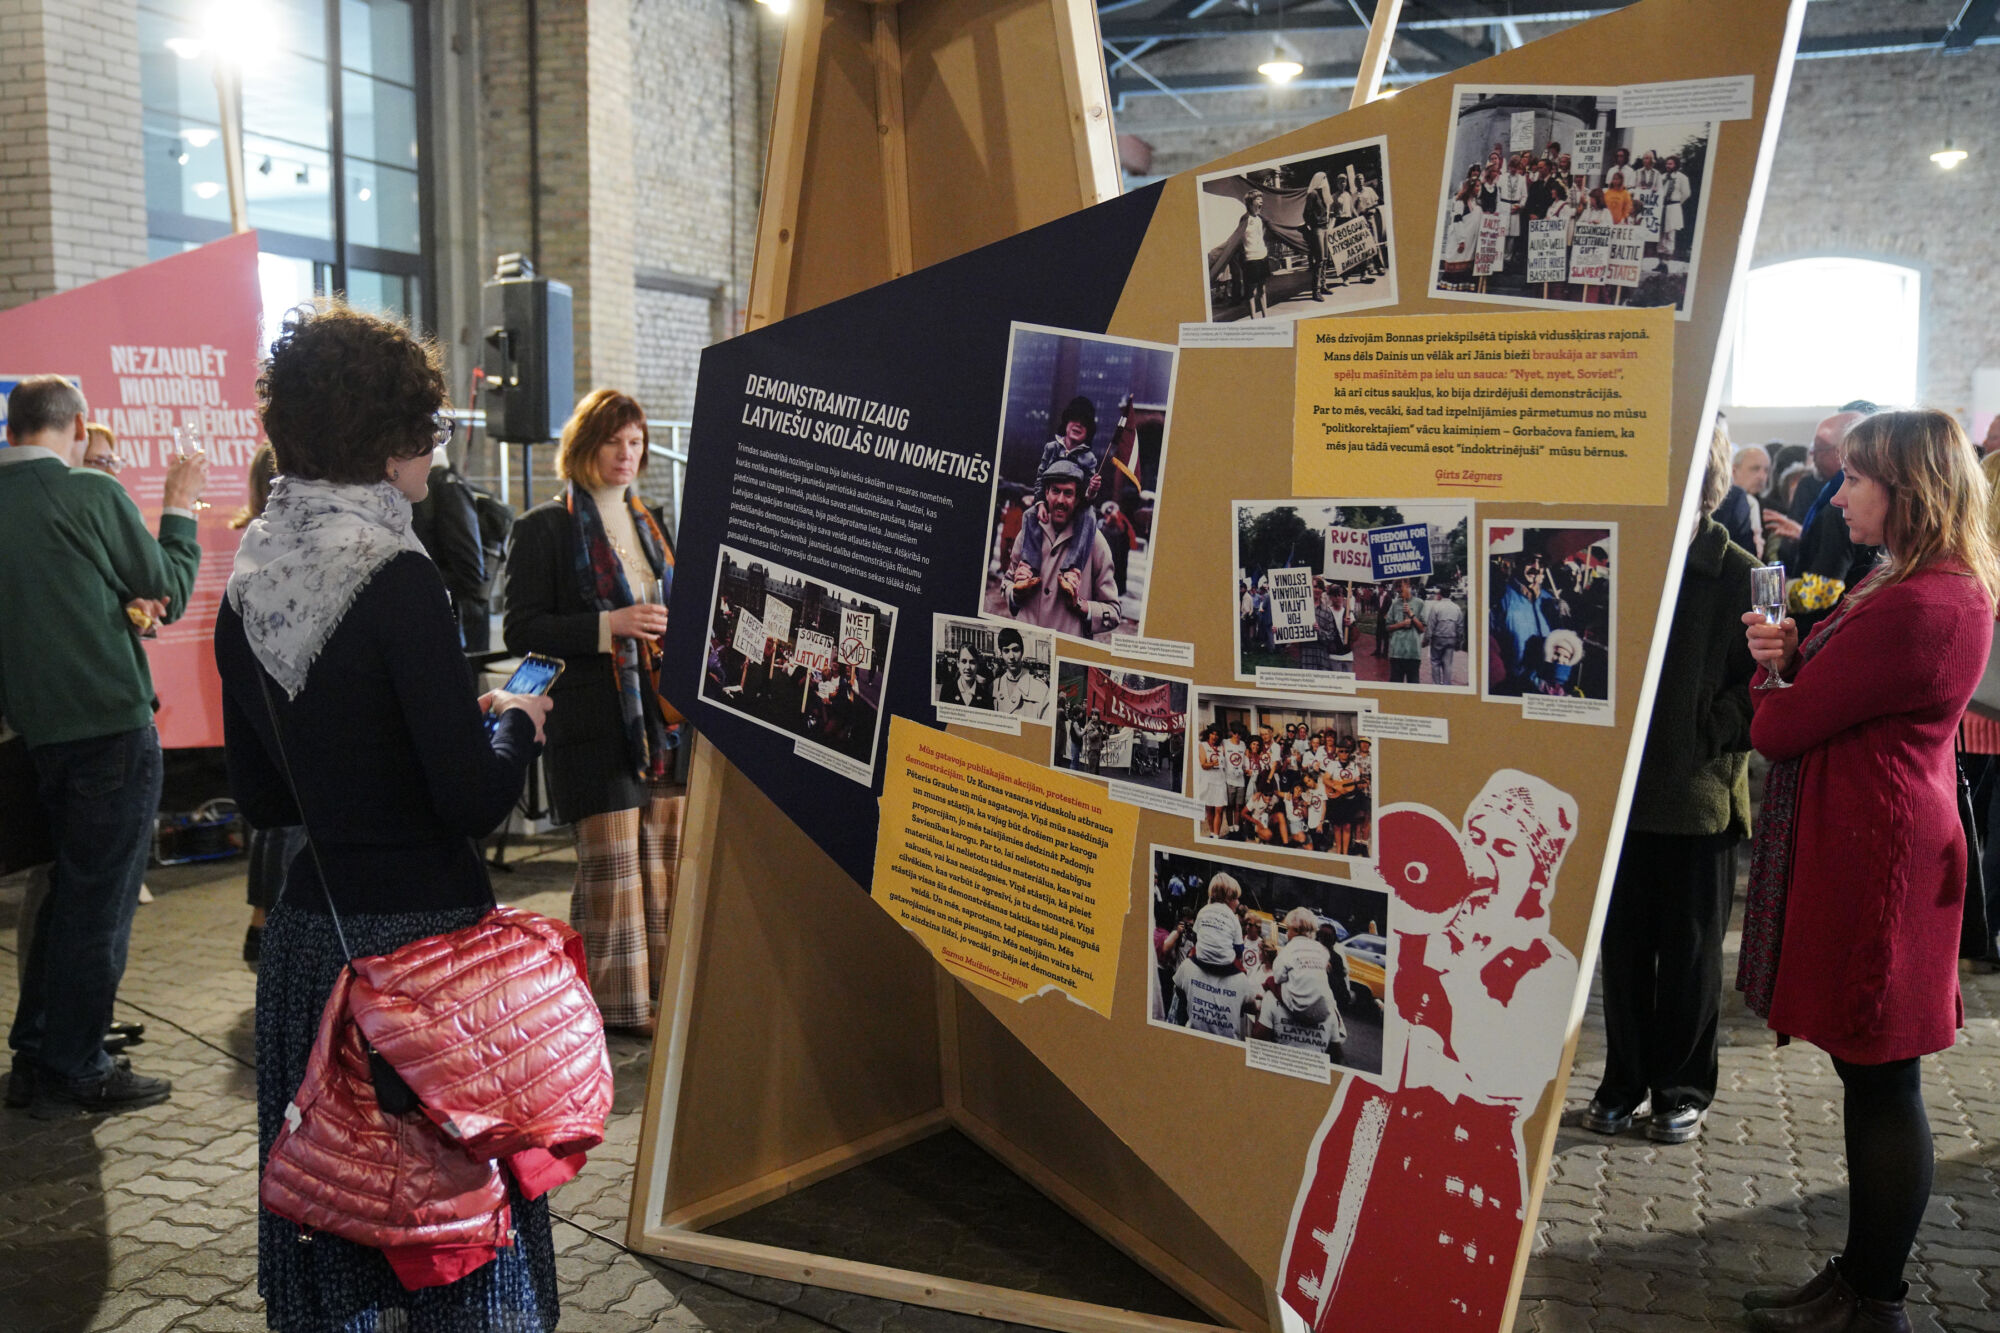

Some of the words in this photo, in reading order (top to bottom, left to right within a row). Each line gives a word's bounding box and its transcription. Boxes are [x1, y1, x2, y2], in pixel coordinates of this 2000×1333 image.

[1611, 228, 1634, 241] FREE
[1610, 244, 1641, 261] BALTIC
[1529, 269, 1565, 282] BASEMENT
[1606, 264, 1639, 281] STATES
[1315, 333, 1336, 343] Mēs
[1337, 332, 1383, 345] dzīvojām
[1385, 332, 1424, 342] Bonnas
[1425, 330, 1496, 344] priekšpilsētā
[1497, 329, 1536, 343] tipiskā
[1538, 328, 1606, 342] vidusšķiras
[1607, 328, 1649, 342] rajonā.
[110, 345, 228, 377] NEZAUDĒT
[1323, 351, 1351, 361] Mans
[1352, 350, 1373, 361] dēls
[1375, 350, 1408, 360] Dainis
[1426, 349, 1454, 360] vēlāk
[1455, 350, 1471, 360] arī
[1472, 349, 1501, 360] Jānis
[1503, 349, 1530, 359] bieži
[1532, 348, 1582, 362] braukāja
[1584, 351, 1597, 359] ar
[1599, 348, 1638, 359] savām
[1333, 368, 1360, 381] spēļu
[1362, 369, 1418, 379] mašīnītēm
[1419, 371, 1432, 382] pa
[1434, 368, 1454, 379] ielu
[1456, 371, 1471, 379] un
[1472, 371, 1507, 379] sauca:
[1546, 369, 1575, 381] nyet,
[744, 373, 861, 419] DEMONSTRANTI
[861, 400, 909, 430] IZAUG
[1334, 386, 1346, 397] kā
[1348, 387, 1362, 397] arī
[1364, 387, 1389, 397] citus
[1391, 386, 1434, 400] saukļus,
[1436, 386, 1449, 397] ko
[1450, 386, 1471, 400] bija
[1472, 386, 1528, 400] dzirdējuši
[1529, 387, 1622, 401] demonstrācijās.
[1312, 404, 1330, 414] Par
[1331, 405, 1342, 414] to
[1343, 405, 1366, 416] mēs,
[1368, 405, 1403, 416] vecāki,
[1405, 405, 1424, 415] šad
[1425, 405, 1443, 416] tad
[1445, 405, 1517, 419] izpelnījāmies
[1518, 407, 1593, 419] pārmetumus
[1595, 410, 1611, 418] no
[1612, 408, 1647, 418] mūsu
[94, 404, 175, 437] KAMĒR
[1415, 424, 1440, 434] vācu
[1442, 424, 1500, 437] kaimiņiem
[1512, 425, 1572, 436] Gorbačova
[1574, 426, 1618, 438] faniem,
[1620, 426, 1634, 438] ka
[741, 403, 812, 438] LATVIEŠU
[812, 420, 872, 453] SKOLĀS
[873, 434, 899, 460] UN
[899, 441, 990, 483] NOMETNĒS
[1325, 440, 1346, 450] mēs
[1347, 440, 1363, 453] jau
[1365, 441, 1388, 451] tādā
[1389, 442, 1430, 452] vecumā
[1431, 444, 1454, 453] esot
[1548, 445, 1581, 456] mūsu
[1583, 445, 1628, 457] bērnus.
[1434, 468, 1460, 481] Ģirts
[1461, 469, 1502, 483] Zēgners
[1331, 530, 1368, 546] RUCK
[1370, 531, 1409, 545] FREEDOM
[1410, 528, 1427, 539] FOR
[1383, 541, 1415, 553] LATVIA,
[1378, 551, 1424, 565] LITHUANIA,
[1383, 562, 1420, 575] ESTONIA!
[1274, 573, 1307, 587] ESTONIA
[1272, 585, 1311, 600] LITHUANIA
[1279, 599, 1307, 612] LATVIA
[847, 612, 871, 628] NYET
[1287, 613, 1302, 624] FOR
[799, 630, 833, 648] SOVIETS
[845, 625, 869, 640] NYET
[1275, 625, 1317, 641] FREEDOM
[795, 649, 830, 671] LATVIA
[839, 642, 872, 664] SOVIET
[934, 751, 966, 767] gatavoja
[966, 762, 1012, 783] publiskajām
[1012, 777, 1044, 795] akcijām,
[1045, 789, 1089, 810] protestiem
[1091, 804, 1101, 815] un
[905, 753, 965, 781] demonstrācijām.
[966, 774, 976, 785] Uz
[977, 778, 1003, 795] Kursas
[1004, 789, 1033, 805] vasaras
[1033, 800, 1076, 821] vidusskolu
[1077, 816, 1113, 834] atbrauca
[906, 768, 931, 783] Pēteris
[932, 777, 958, 793] Graube
[959, 789, 969, 798] un
[987, 799, 1029, 819] sagatavoja.
[941, 946, 964, 961] Sarma
[964, 955, 1028, 989] Muižniece-Liepiņa
[1191, 978, 1221, 994] FREEDOM
[1222, 988, 1237, 998] FOR
[1192, 1005, 1228, 1021] LATVIA
[1283, 1026, 1322, 1039] LATVIA
